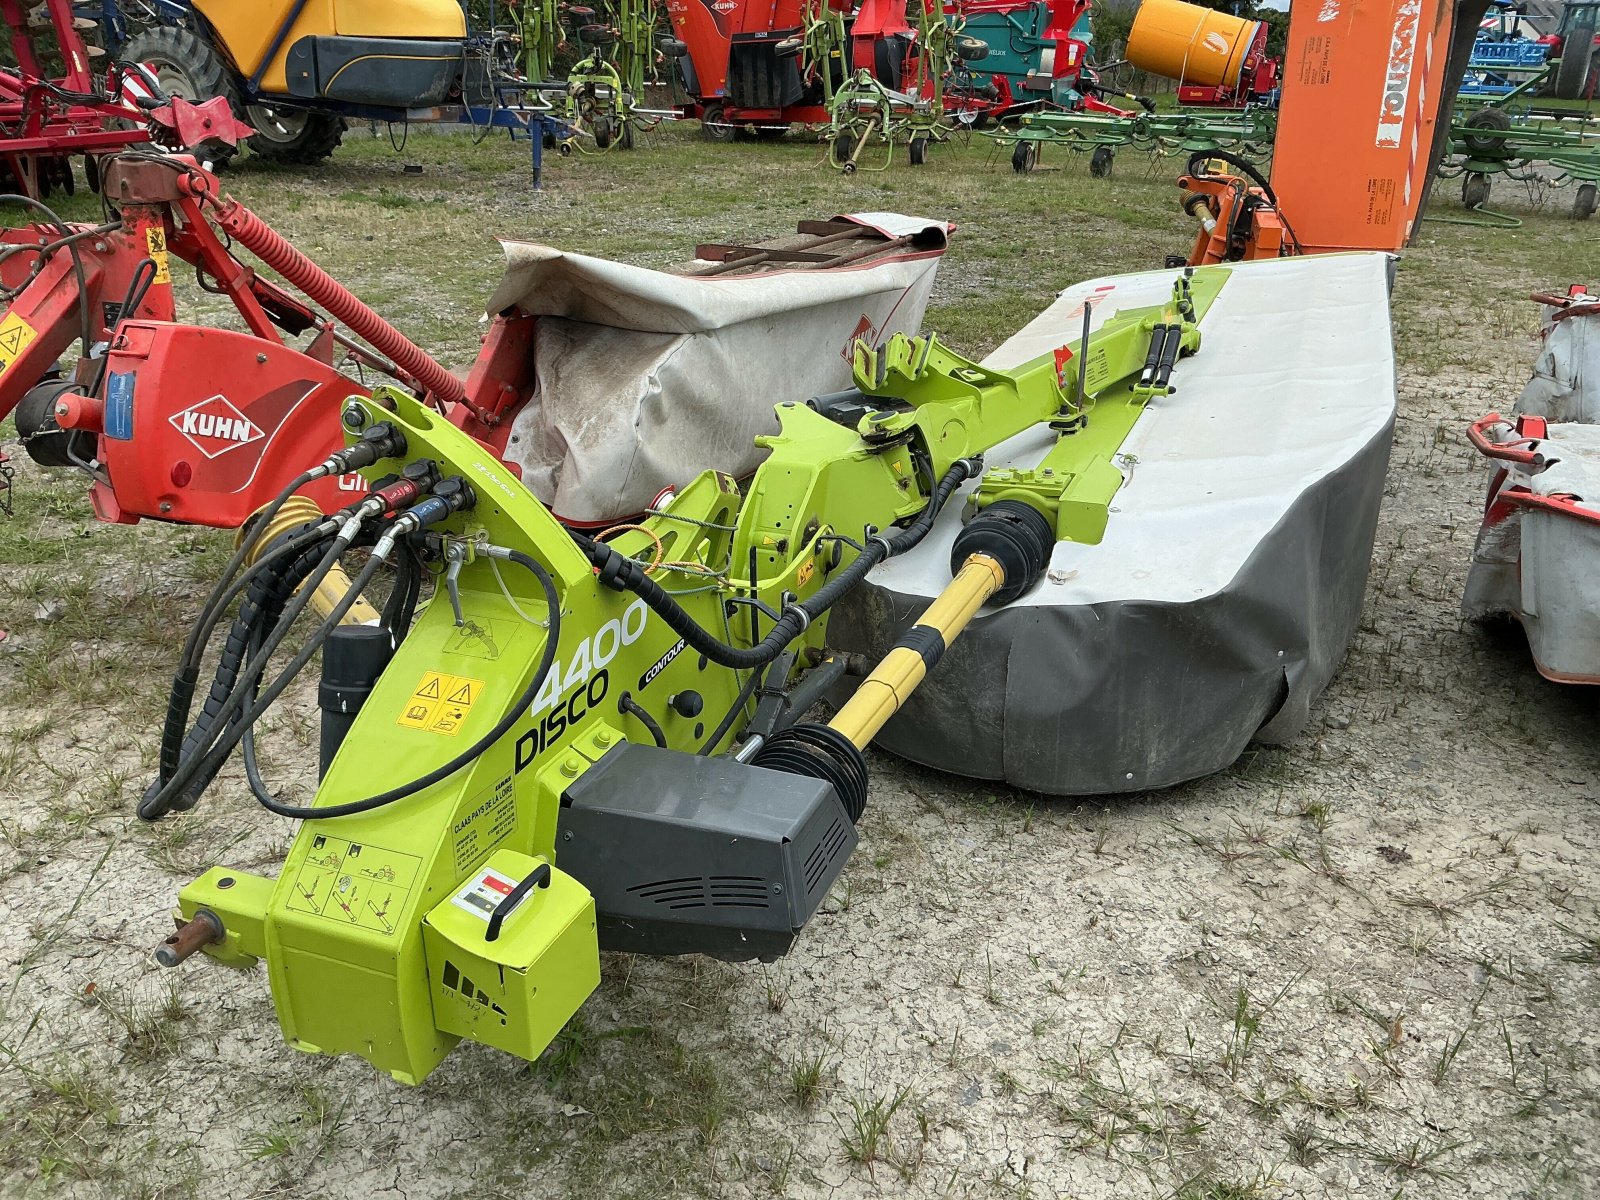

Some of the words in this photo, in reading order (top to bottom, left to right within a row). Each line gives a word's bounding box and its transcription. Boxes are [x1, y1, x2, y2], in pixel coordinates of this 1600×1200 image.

[714, 2, 735, 10] KUHN
[182, 411, 251, 442] KUHN
[531, 598, 648, 718] 4400
[645, 638, 685, 683] CONTOUR
[515, 668, 609, 775] DISCO
[454, 815, 471, 834] CLAAS
[471, 805, 485, 820] PAYS
[485, 799, 492, 811] DE
[492, 794, 499, 805] LA
[499, 783, 513, 800] LOIRE
